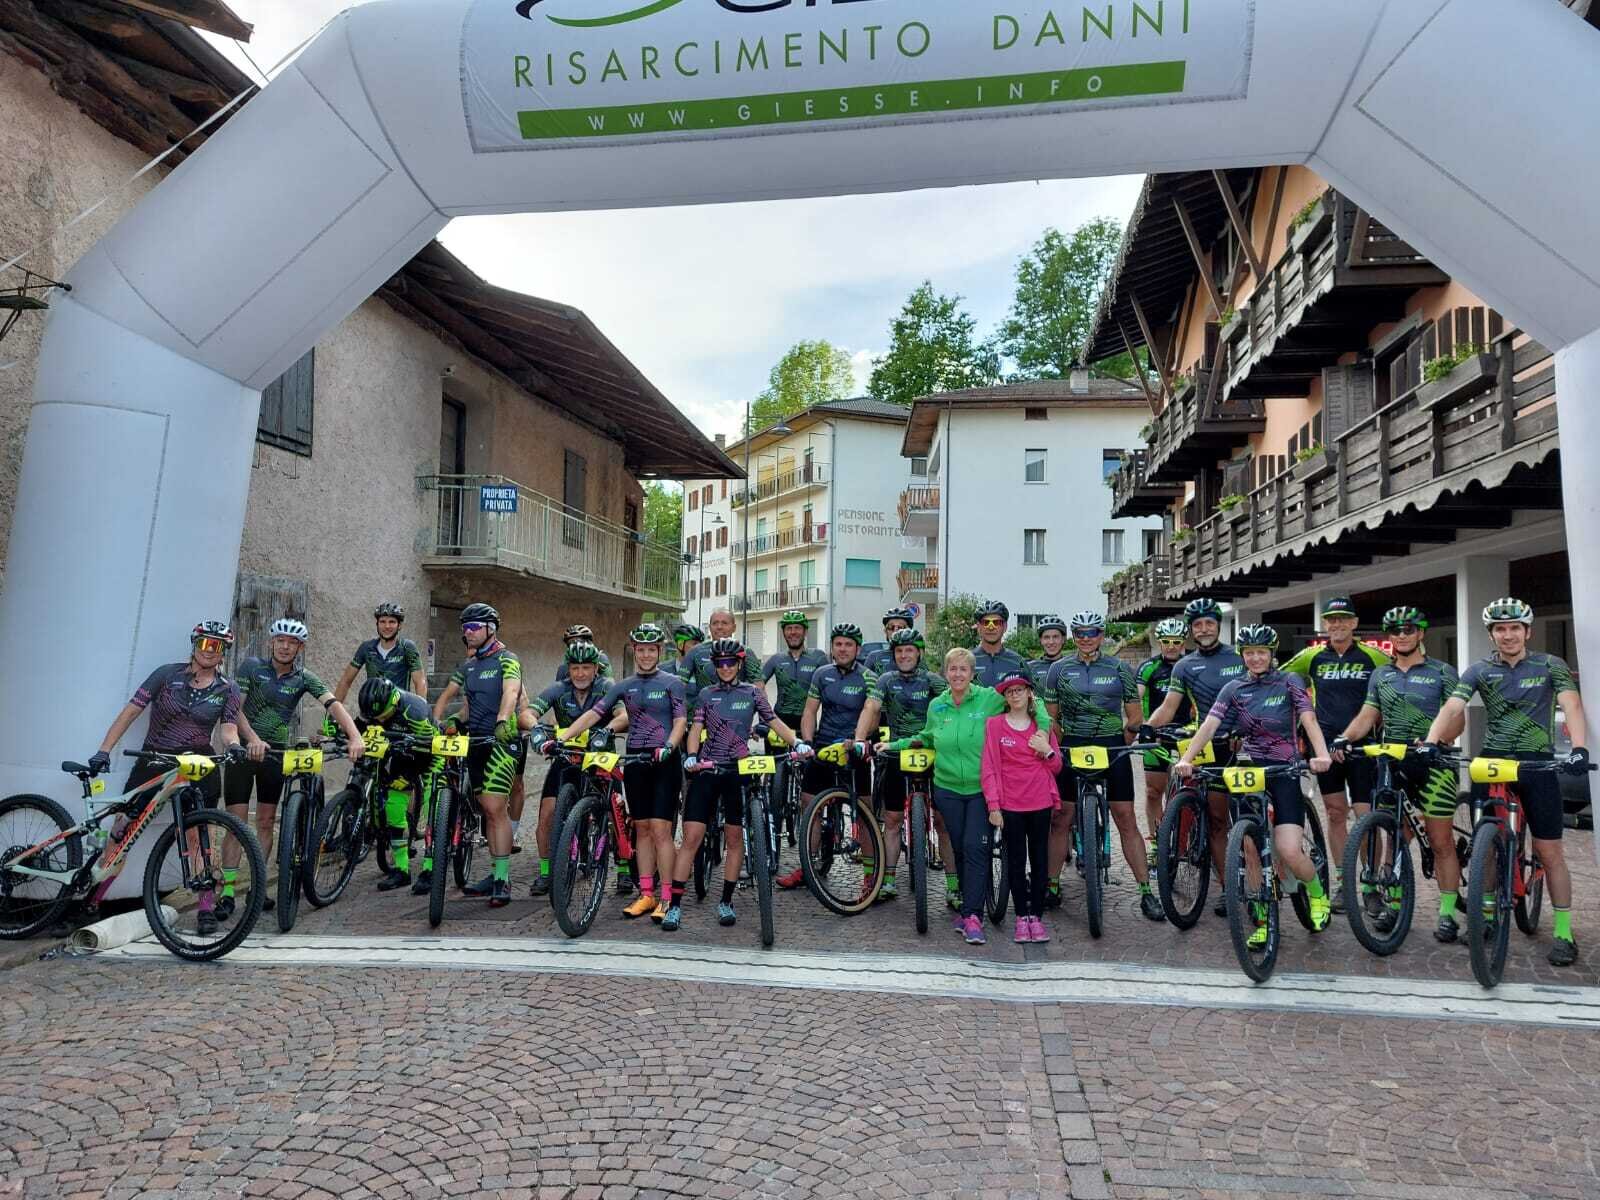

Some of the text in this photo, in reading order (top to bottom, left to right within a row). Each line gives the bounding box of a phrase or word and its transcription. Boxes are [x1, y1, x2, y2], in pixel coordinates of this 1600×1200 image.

[514, 0, 1189, 88] RISARCIMENTO DANNI
[485, 499, 513, 511] PRIVATA
[440, 738, 460, 752] 15
[825, 750, 840, 762] 23
[908, 754, 928, 768] 13
[1084, 753, 1095, 767] 9
[294, 757, 314, 770] 19
[747, 759, 767, 770] 25
[1487, 763, 1499, 778] 5
[1232, 771, 1256, 788] 18
